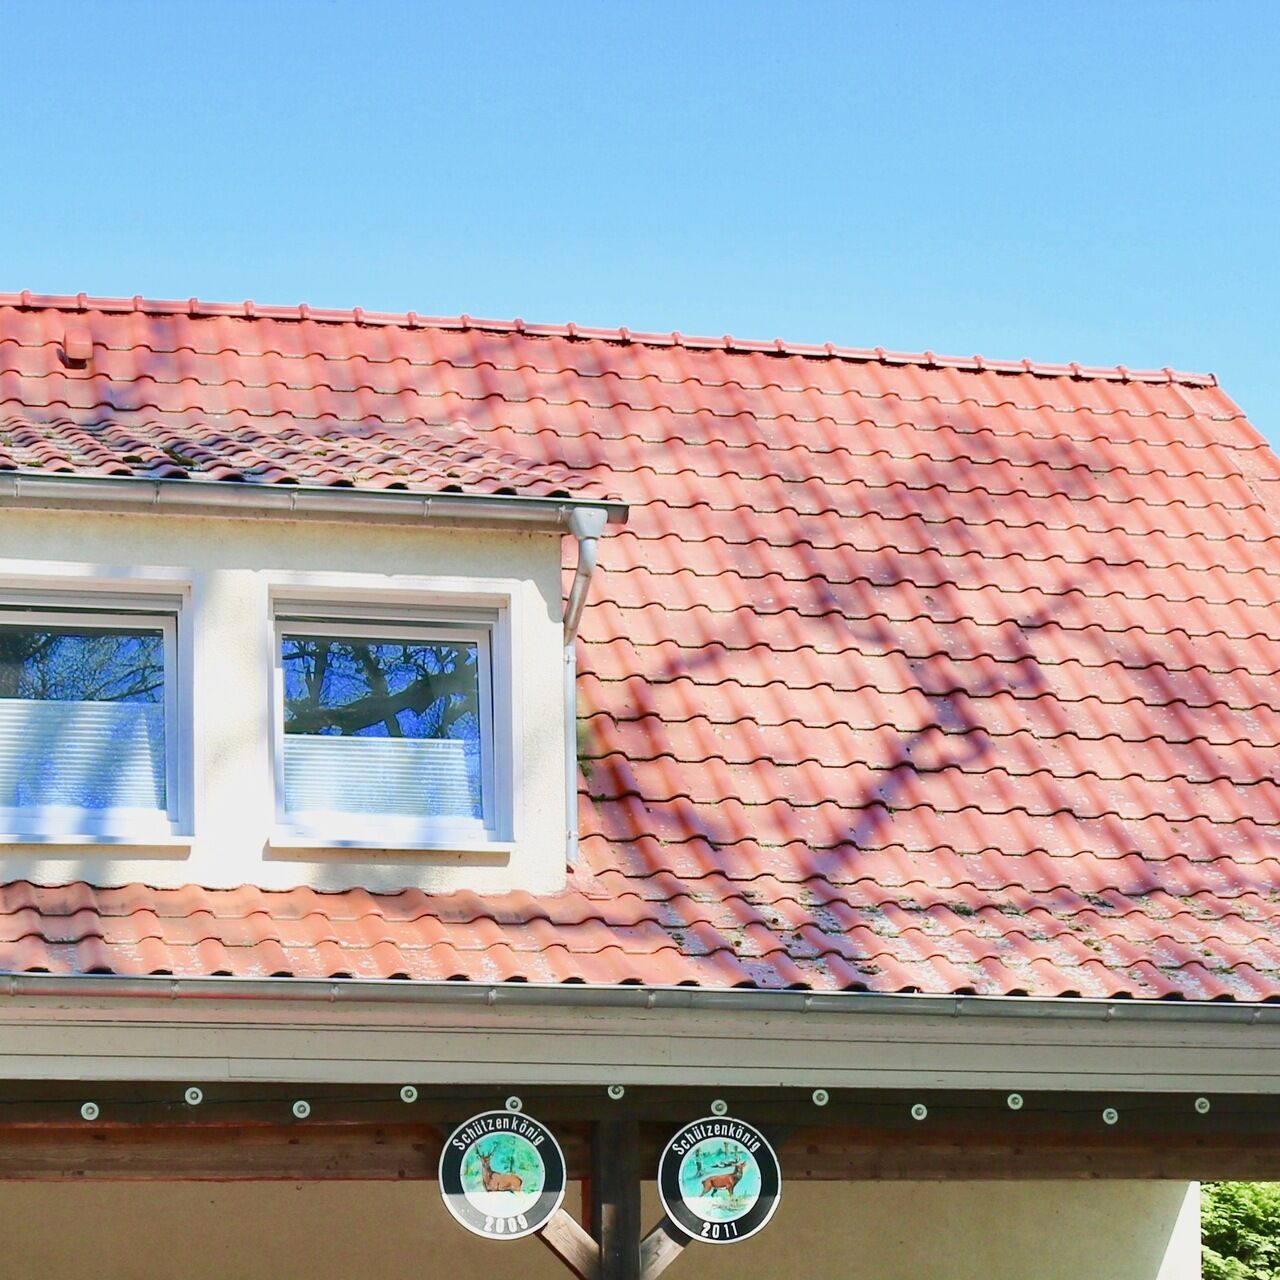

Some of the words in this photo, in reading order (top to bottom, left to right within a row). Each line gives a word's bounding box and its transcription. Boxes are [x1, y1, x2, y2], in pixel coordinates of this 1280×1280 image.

[453, 1116, 545, 1151] Schützenkönig
[673, 1123, 761, 1155] Schützenkönig
[484, 1214, 528, 1232] 2009
[701, 1222, 738, 1239] 2011
